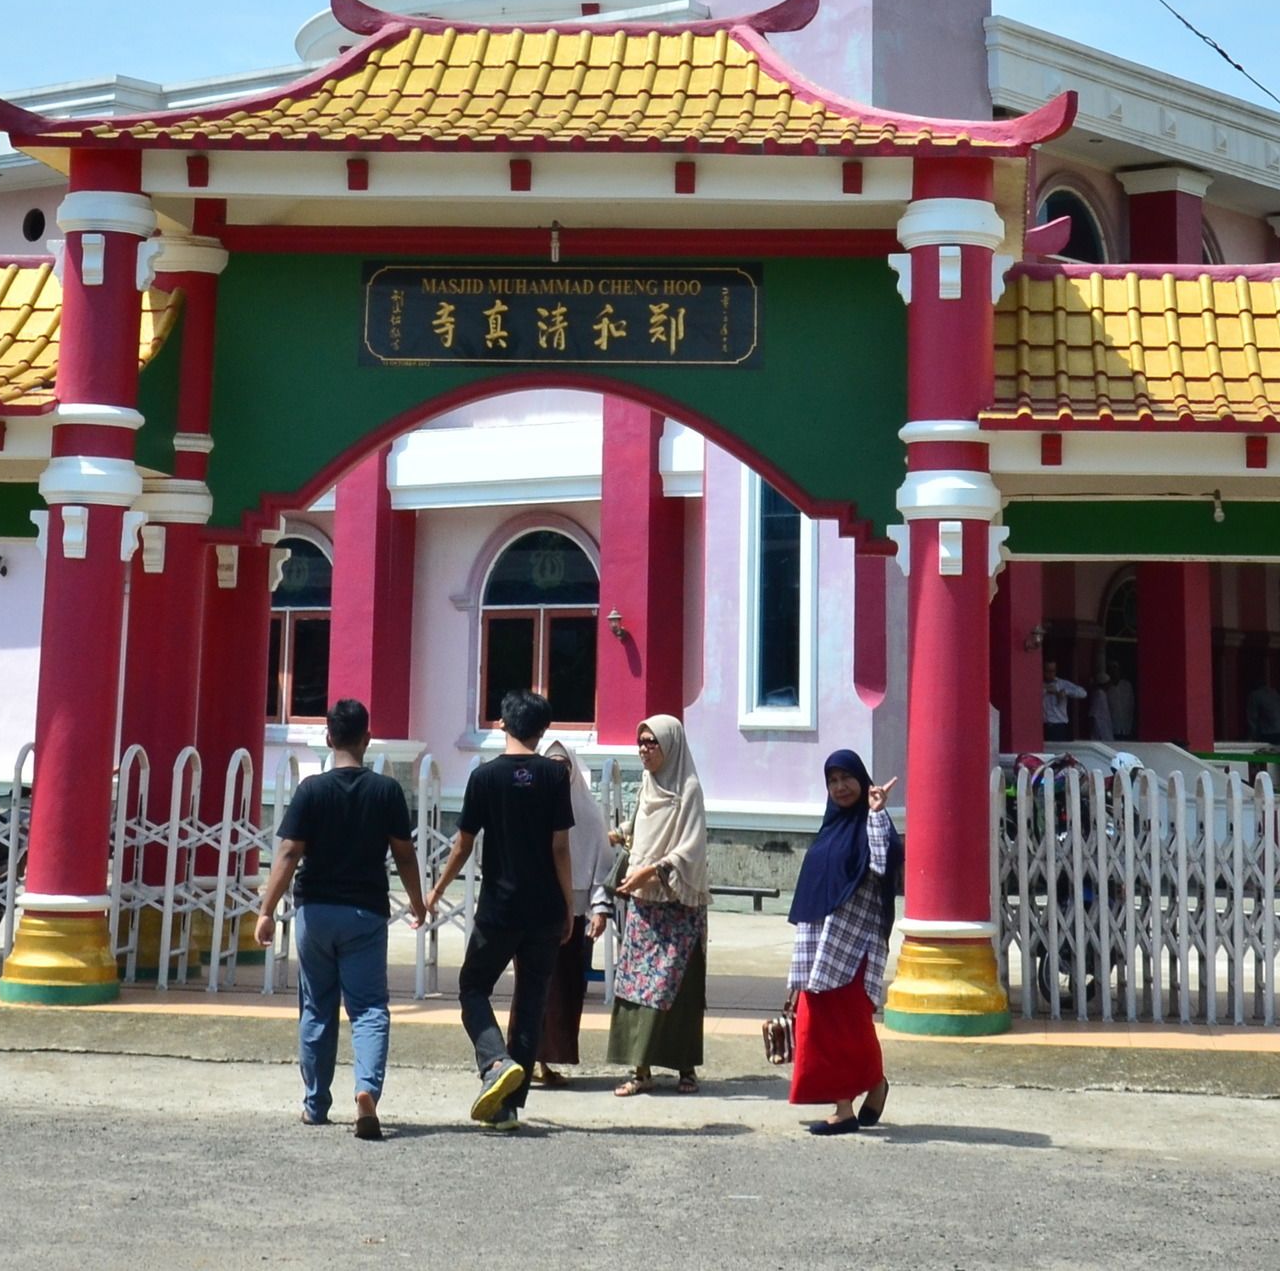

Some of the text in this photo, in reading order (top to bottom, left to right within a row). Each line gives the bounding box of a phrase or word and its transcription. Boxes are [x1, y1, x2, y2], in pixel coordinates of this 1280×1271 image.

[421, 278, 701, 296] MASJID MUHAMMAD CHENG HOO
